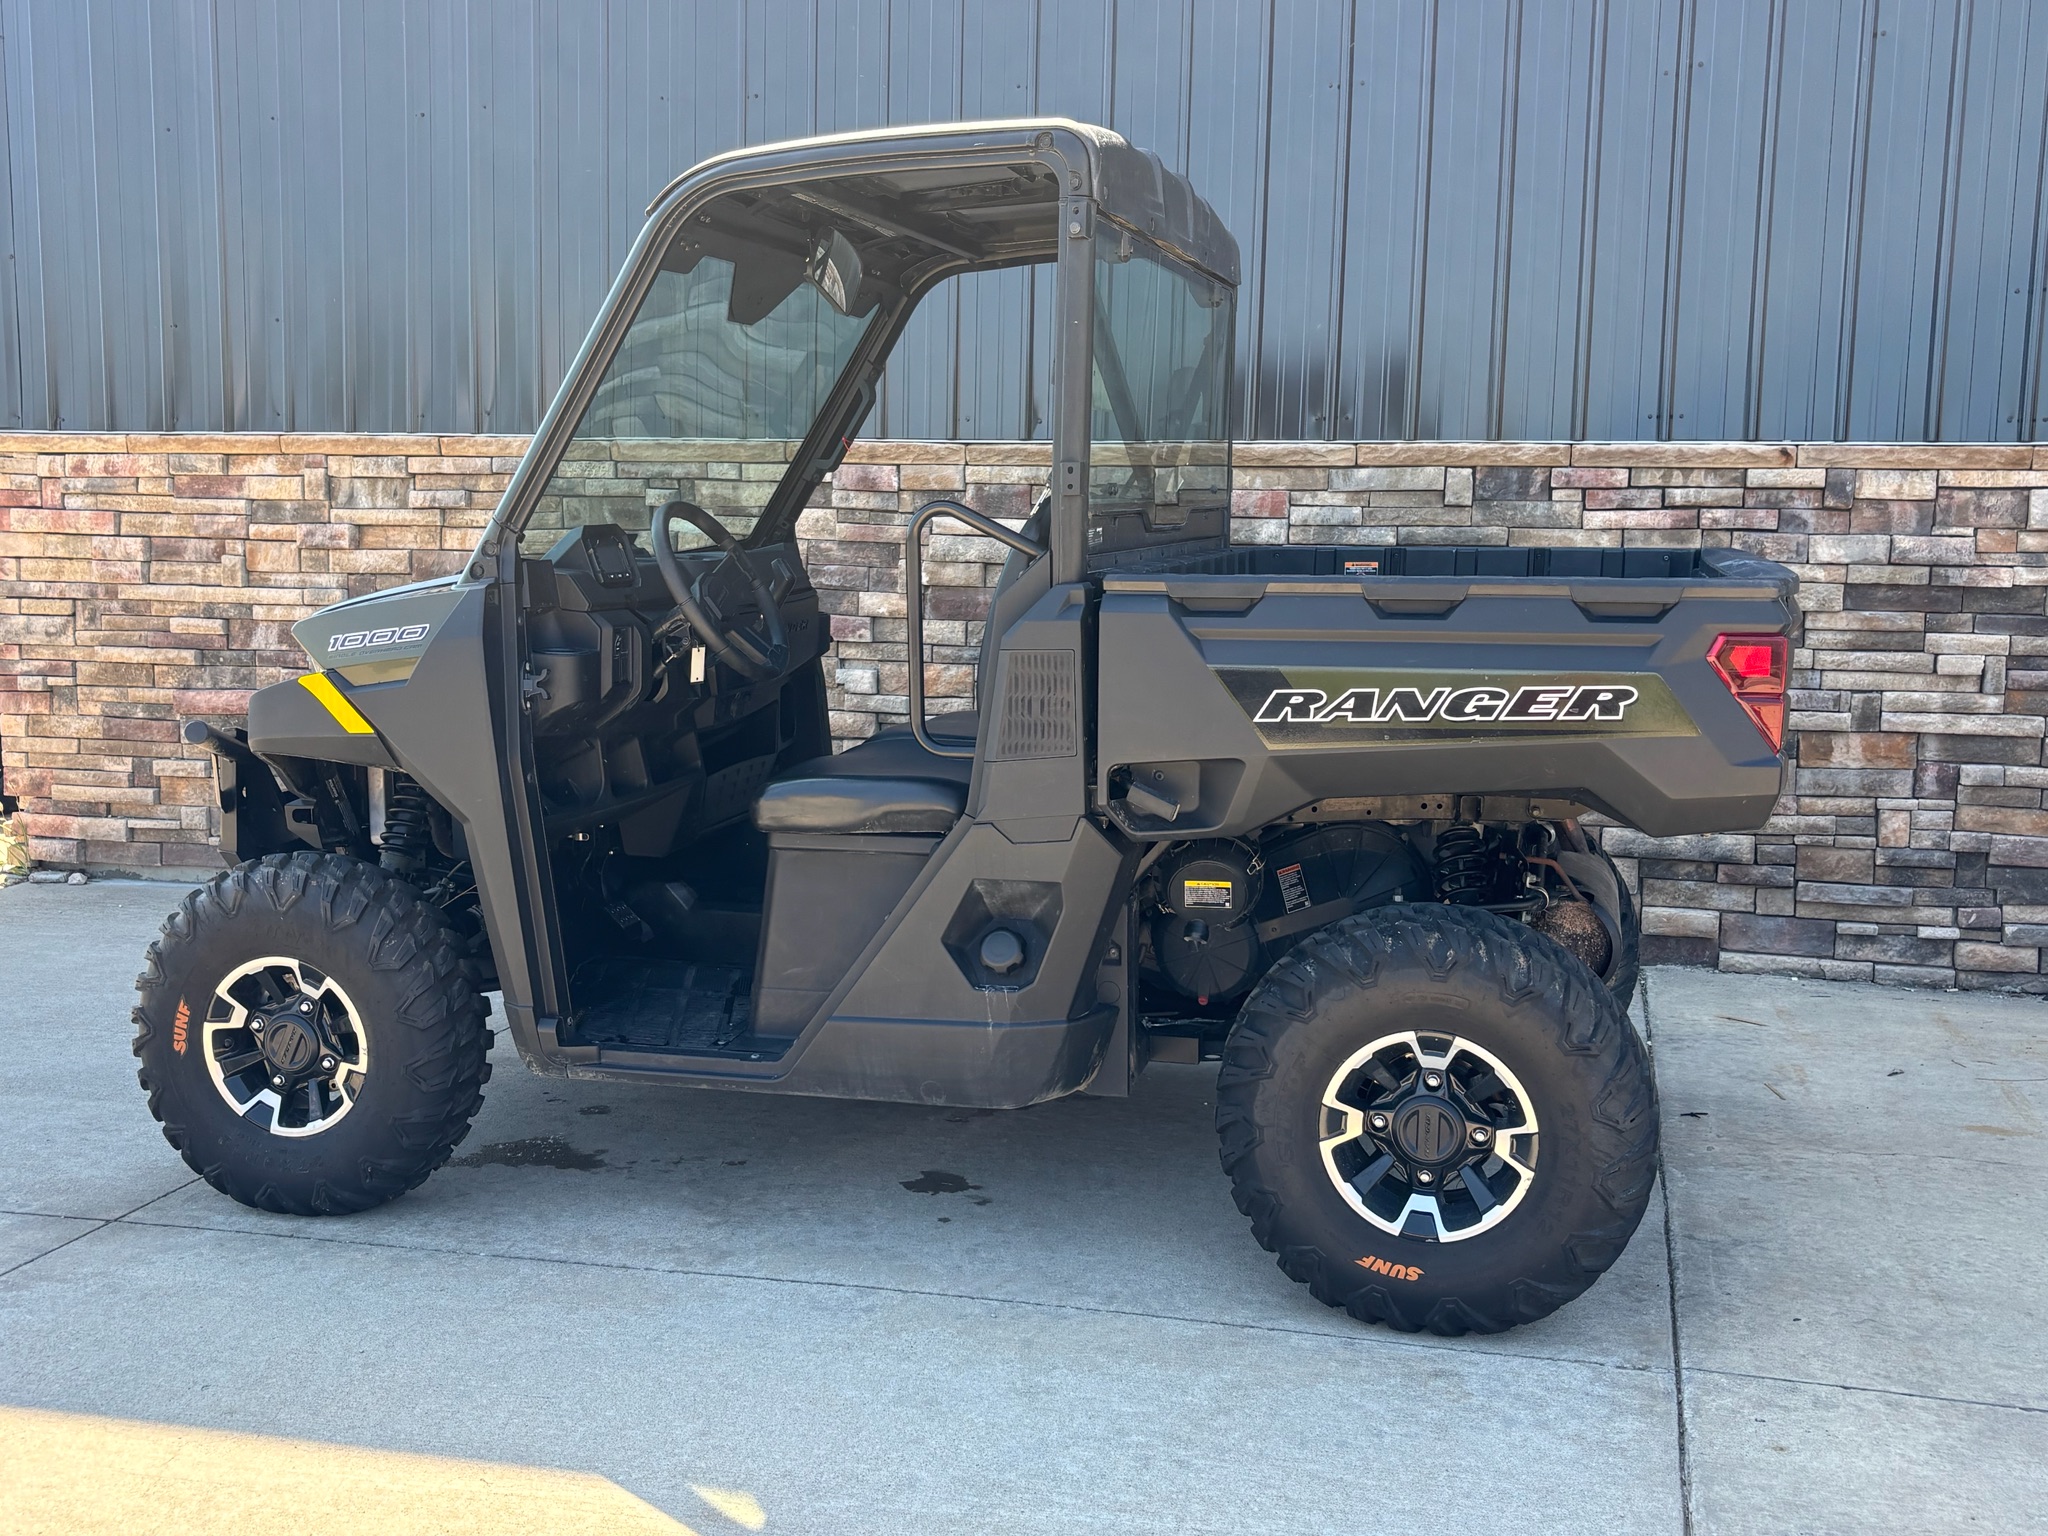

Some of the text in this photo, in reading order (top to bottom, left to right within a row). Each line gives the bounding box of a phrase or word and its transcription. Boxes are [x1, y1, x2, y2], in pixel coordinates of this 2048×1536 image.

[328, 623, 430, 652] 1000
[1253, 685, 1638, 722] RANGER
[173, 998, 190, 1056] SUNF
[1354, 1255, 1425, 1281] SUNF
